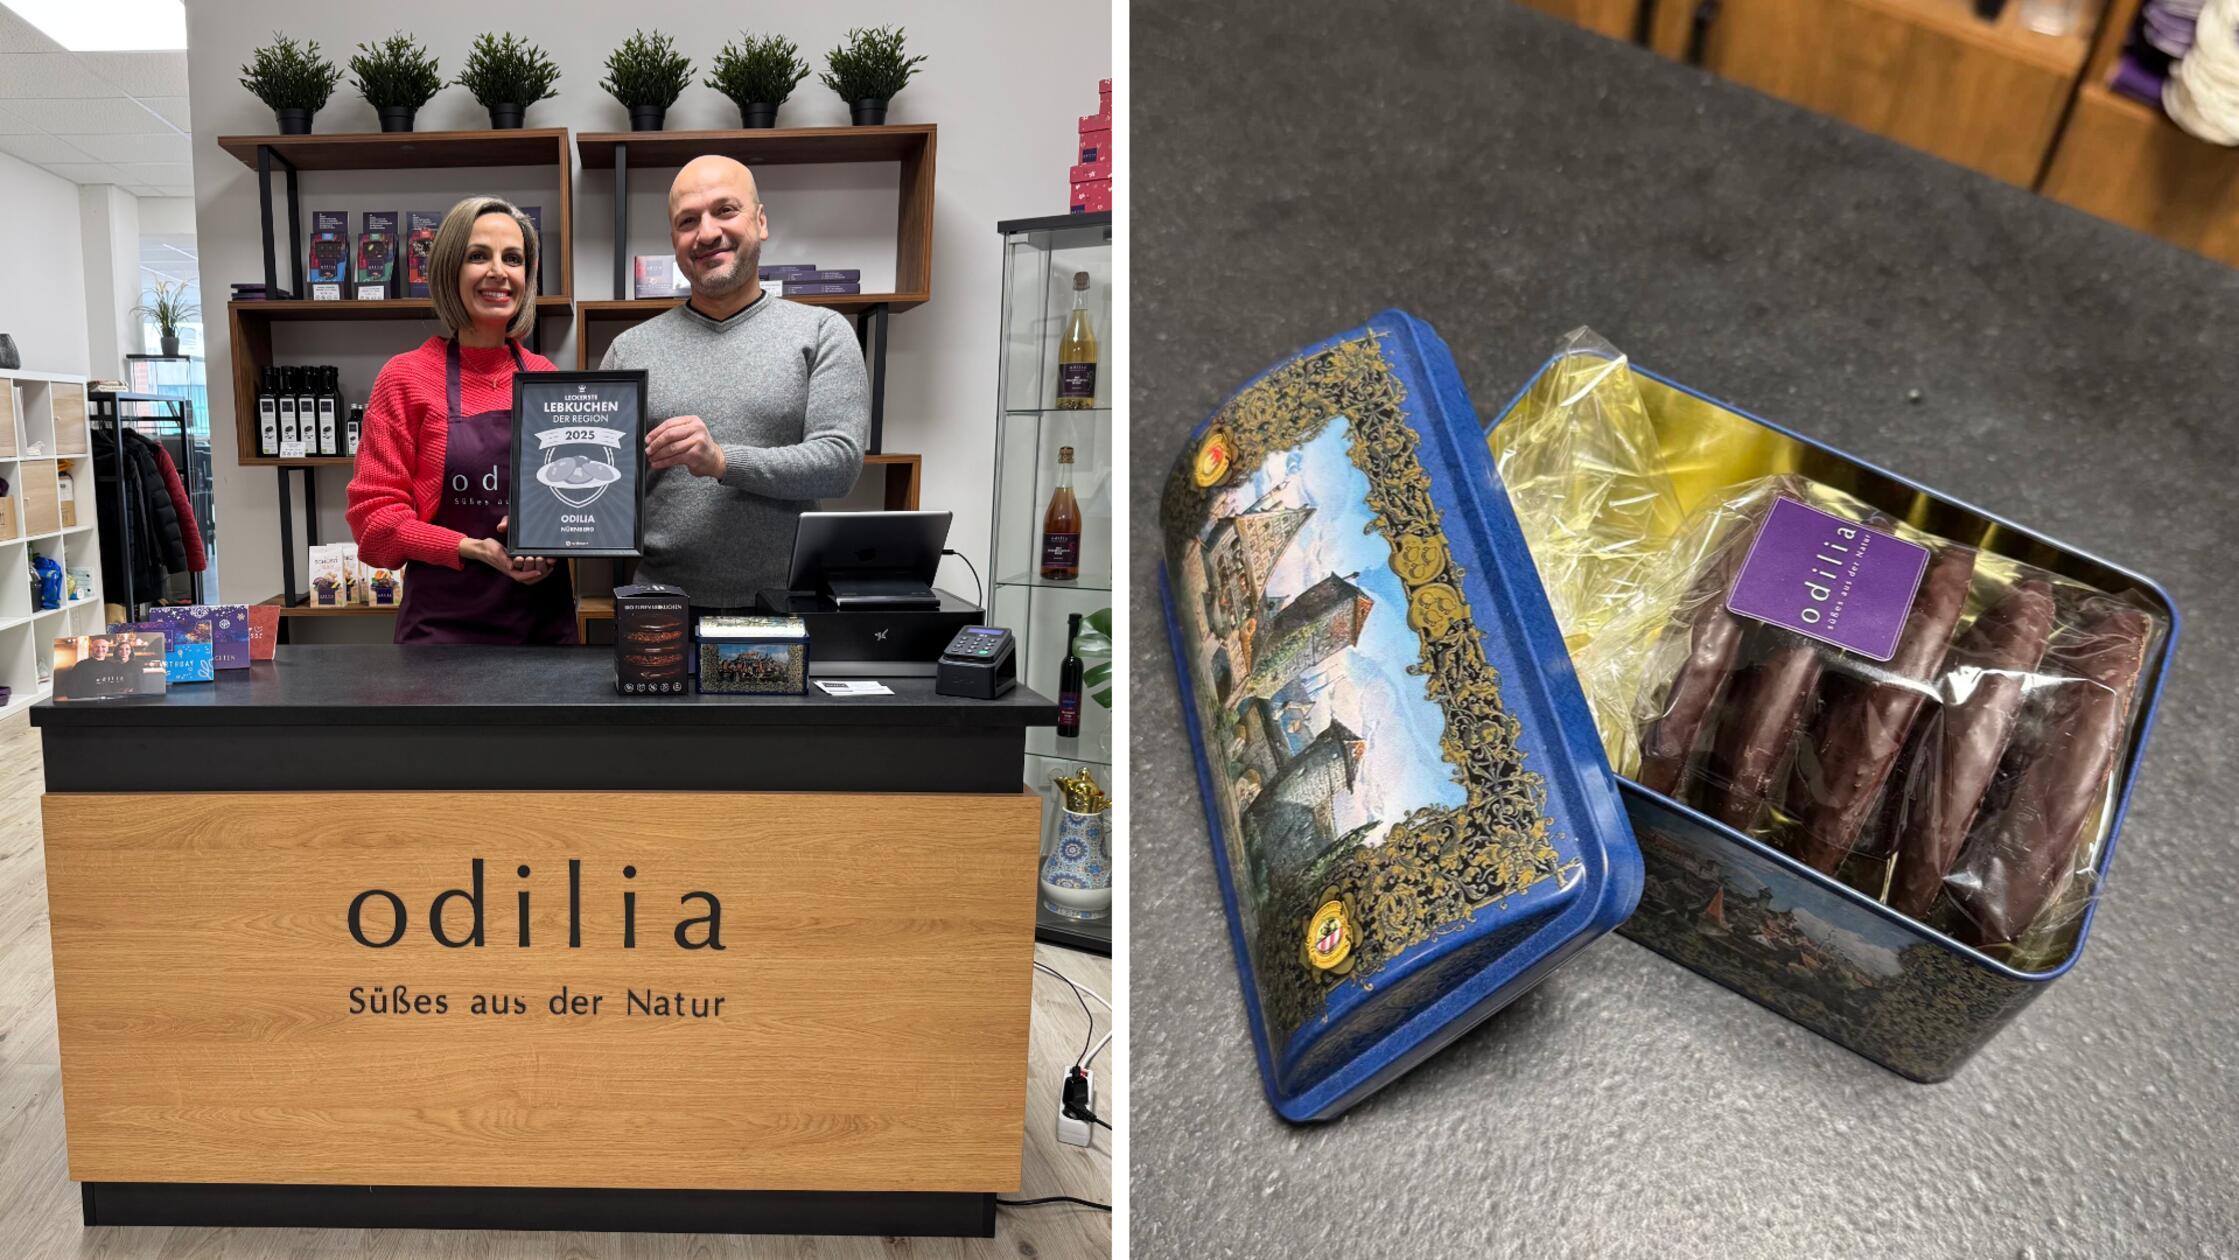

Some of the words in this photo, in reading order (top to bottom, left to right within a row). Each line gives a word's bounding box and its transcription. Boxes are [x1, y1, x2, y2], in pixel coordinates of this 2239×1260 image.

[544, 401, 619, 413] LEBKUCHEN
[553, 414, 570, 423] DER
[572, 413, 609, 423] REGION
[565, 430, 596, 441] 2025
[560, 514, 596, 523] ODILIA
[1801, 527, 1857, 623] odilia
[1840, 580, 1852, 597] aus
[1848, 562, 1860, 577] der
[1855, 534, 1871, 559] Natur
[347, 857, 727, 951] odilia
[348, 985, 449, 1015] Süßes
[470, 993, 527, 1016] aus
[548, 986, 603, 1015] der
[626, 988, 726, 1018] Natur
